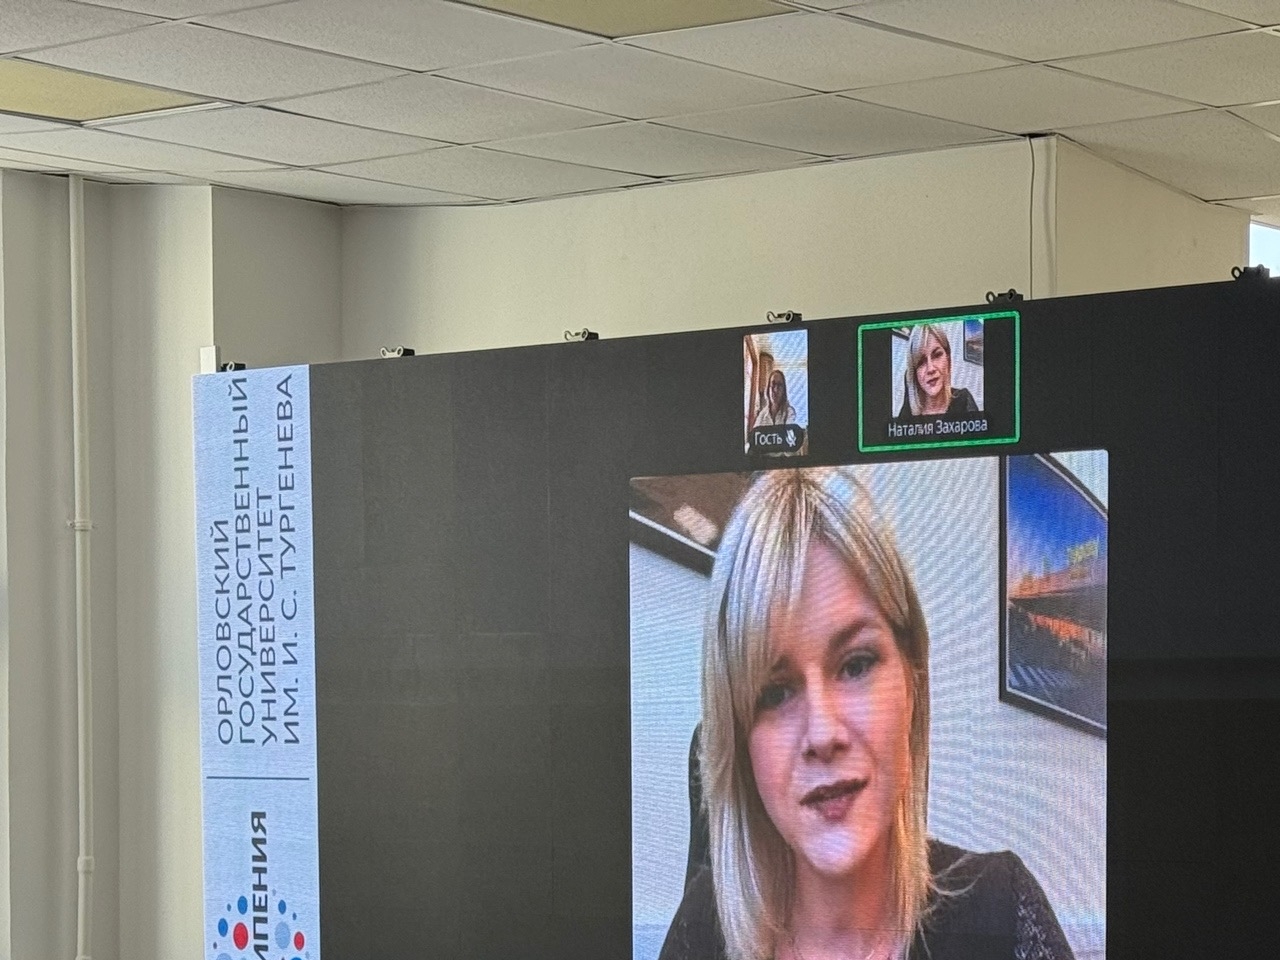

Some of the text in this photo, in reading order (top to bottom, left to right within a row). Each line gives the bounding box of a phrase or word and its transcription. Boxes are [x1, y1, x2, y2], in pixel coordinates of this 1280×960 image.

[754, 430, 783, 447] Гость
[887, 419, 988, 438] Наталия Захарова
[209, 518, 234, 746] ОРЛОВСКИЙ
[227, 376, 256, 746] ГОСУДАРСТВЕННЫЙ
[255, 486, 279, 747] УНИВЕРСИТЕТ
[276, 373, 301, 746] ИМ. И. С. ТУРГЕНЕВА
